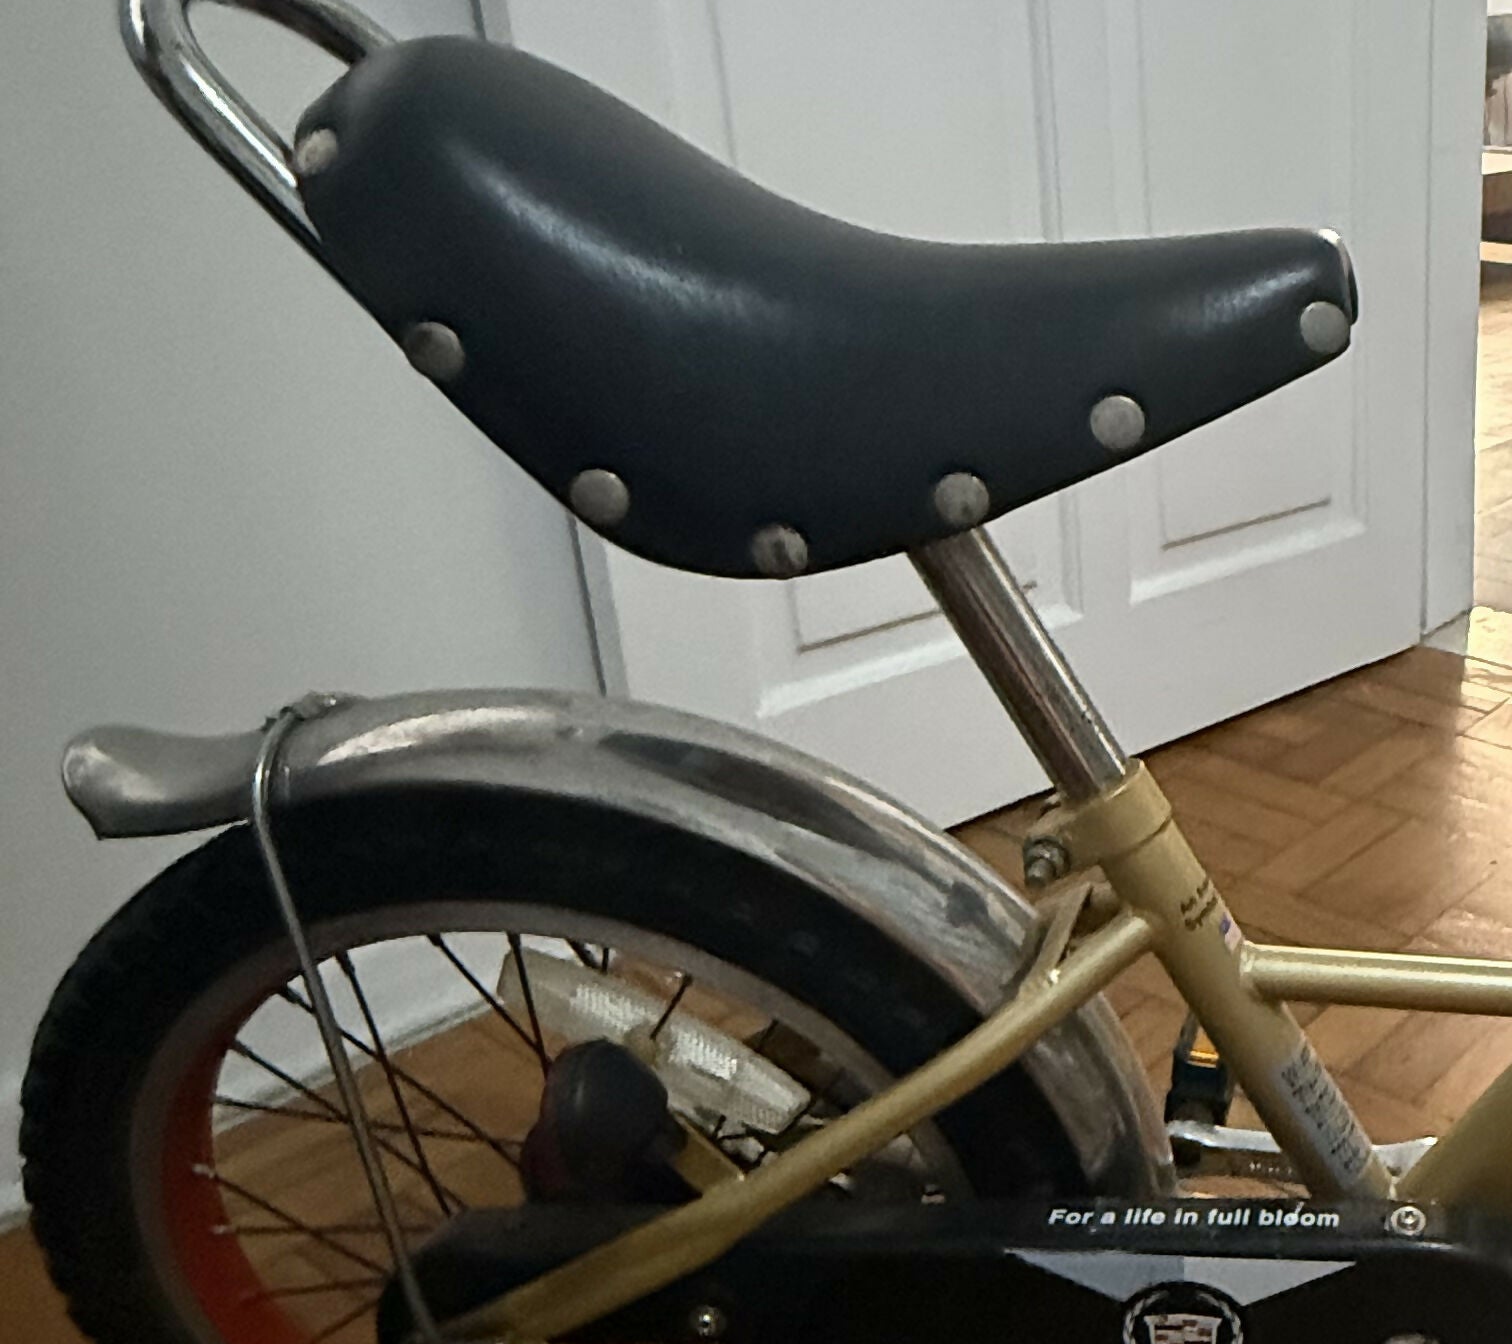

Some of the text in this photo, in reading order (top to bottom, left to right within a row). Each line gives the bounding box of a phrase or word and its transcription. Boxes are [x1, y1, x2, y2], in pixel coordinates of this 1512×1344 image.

[1048, 1207, 1339, 1227] For a life in full bloom
